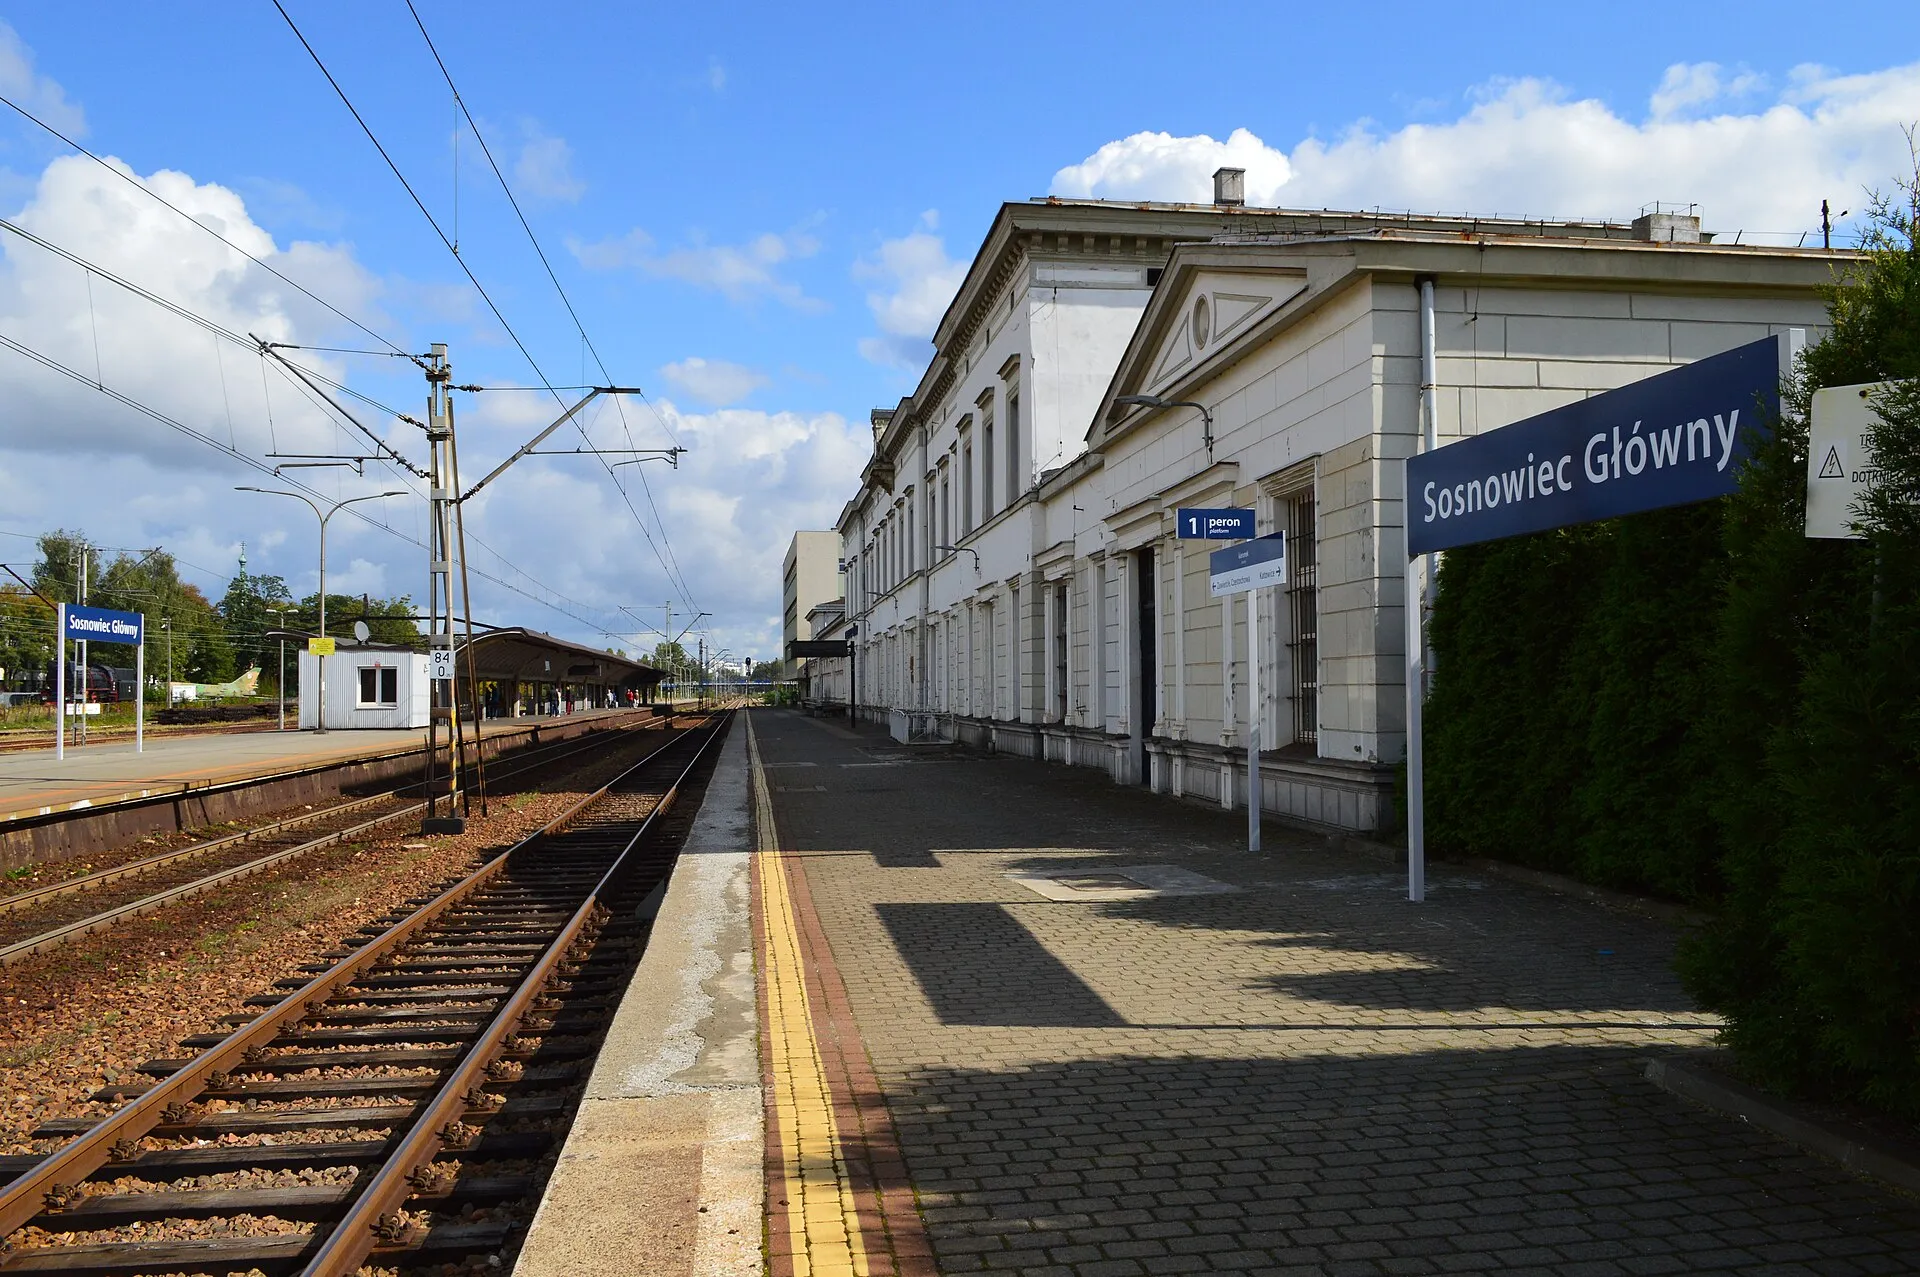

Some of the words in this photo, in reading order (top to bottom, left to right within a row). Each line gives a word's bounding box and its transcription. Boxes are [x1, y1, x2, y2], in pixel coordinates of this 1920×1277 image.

[1423, 452, 1573, 523] Sosnowiec
[1583, 408, 1740, 485] Główny
[1188, 517, 1197, 535] 1
[1208, 517, 1241, 528] peron
[69, 614, 111, 633] Sosnowiec
[111, 619, 139, 640] Główny
[434, 652, 450, 663] 84
[438, 665, 445, 677] 0
